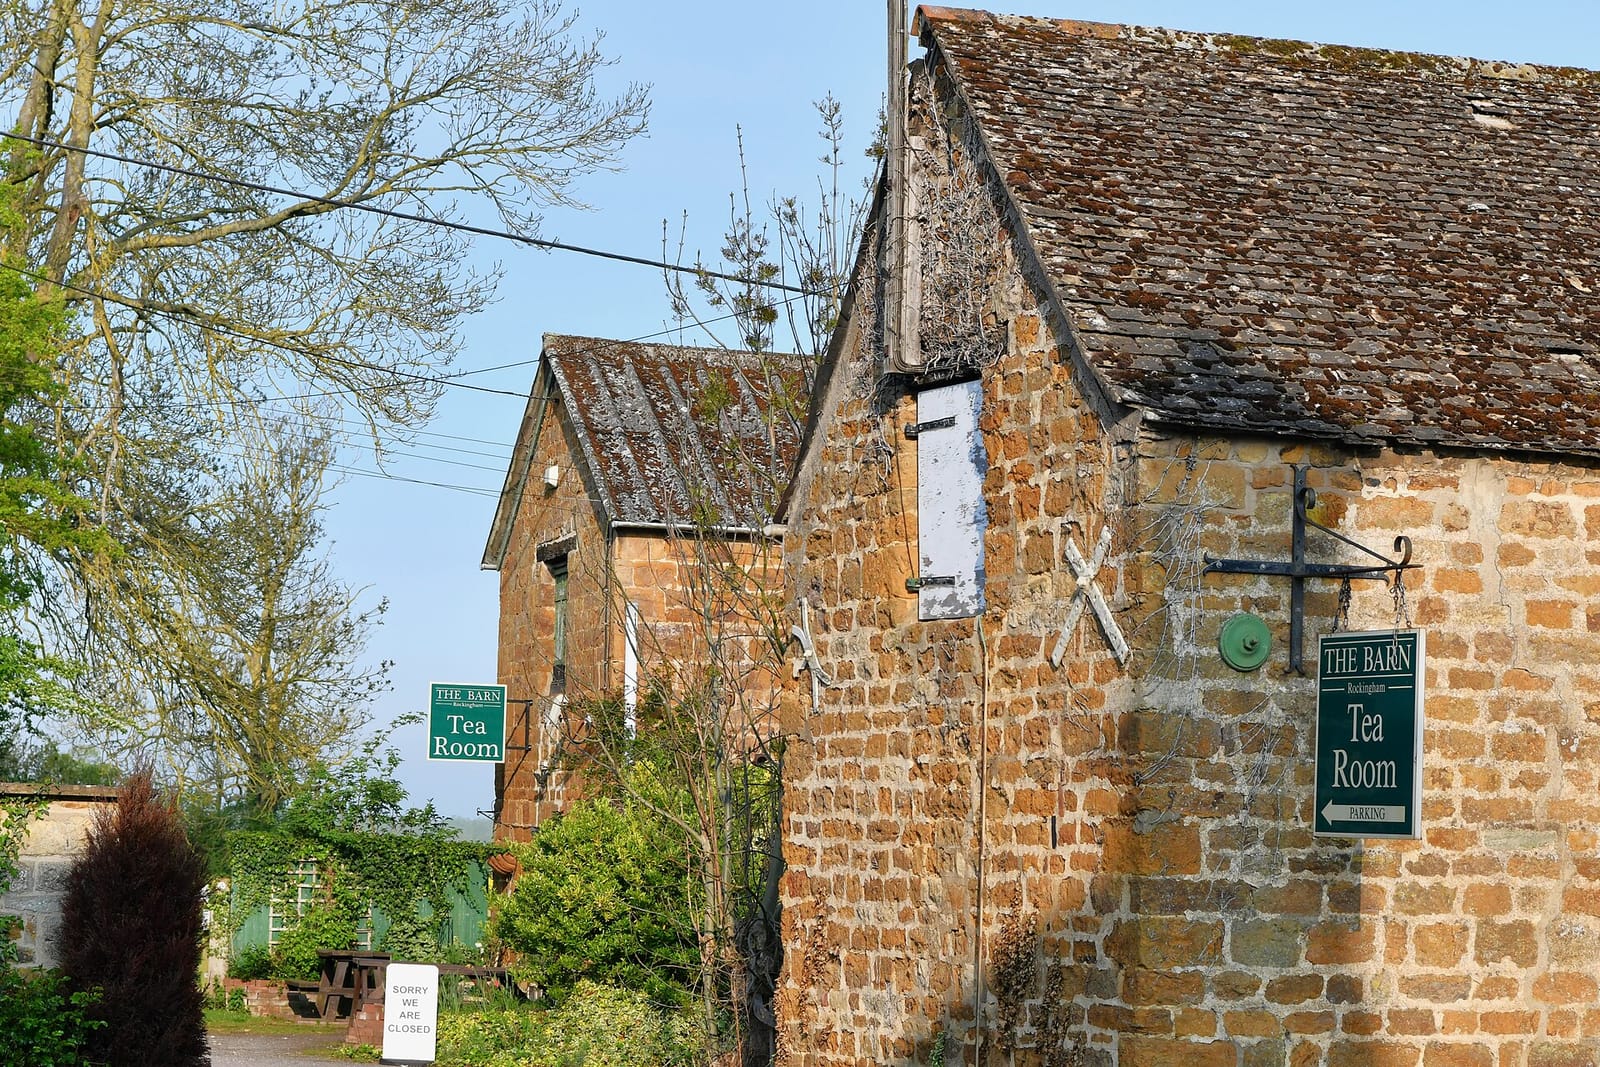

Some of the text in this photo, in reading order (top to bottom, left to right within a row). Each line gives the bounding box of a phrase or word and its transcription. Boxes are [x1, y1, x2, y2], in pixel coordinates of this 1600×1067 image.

[1324, 644, 1412, 674] THE BARN
[437, 689, 501, 702] THE BARN
[1347, 682, 1386, 696] Rockingham
[446, 715, 487, 735] Tea
[1347, 703, 1384, 743] Tea
[433, 736, 500, 758] Room
[1332, 749, 1398, 789] Room
[1349, 807, 1386, 820] PARKING
[392, 985, 429, 994] SORRY
[402, 998, 419, 1007] WE
[399, 1011, 421, 1020] ARE
[387, 1024, 431, 1034] CLOSED
